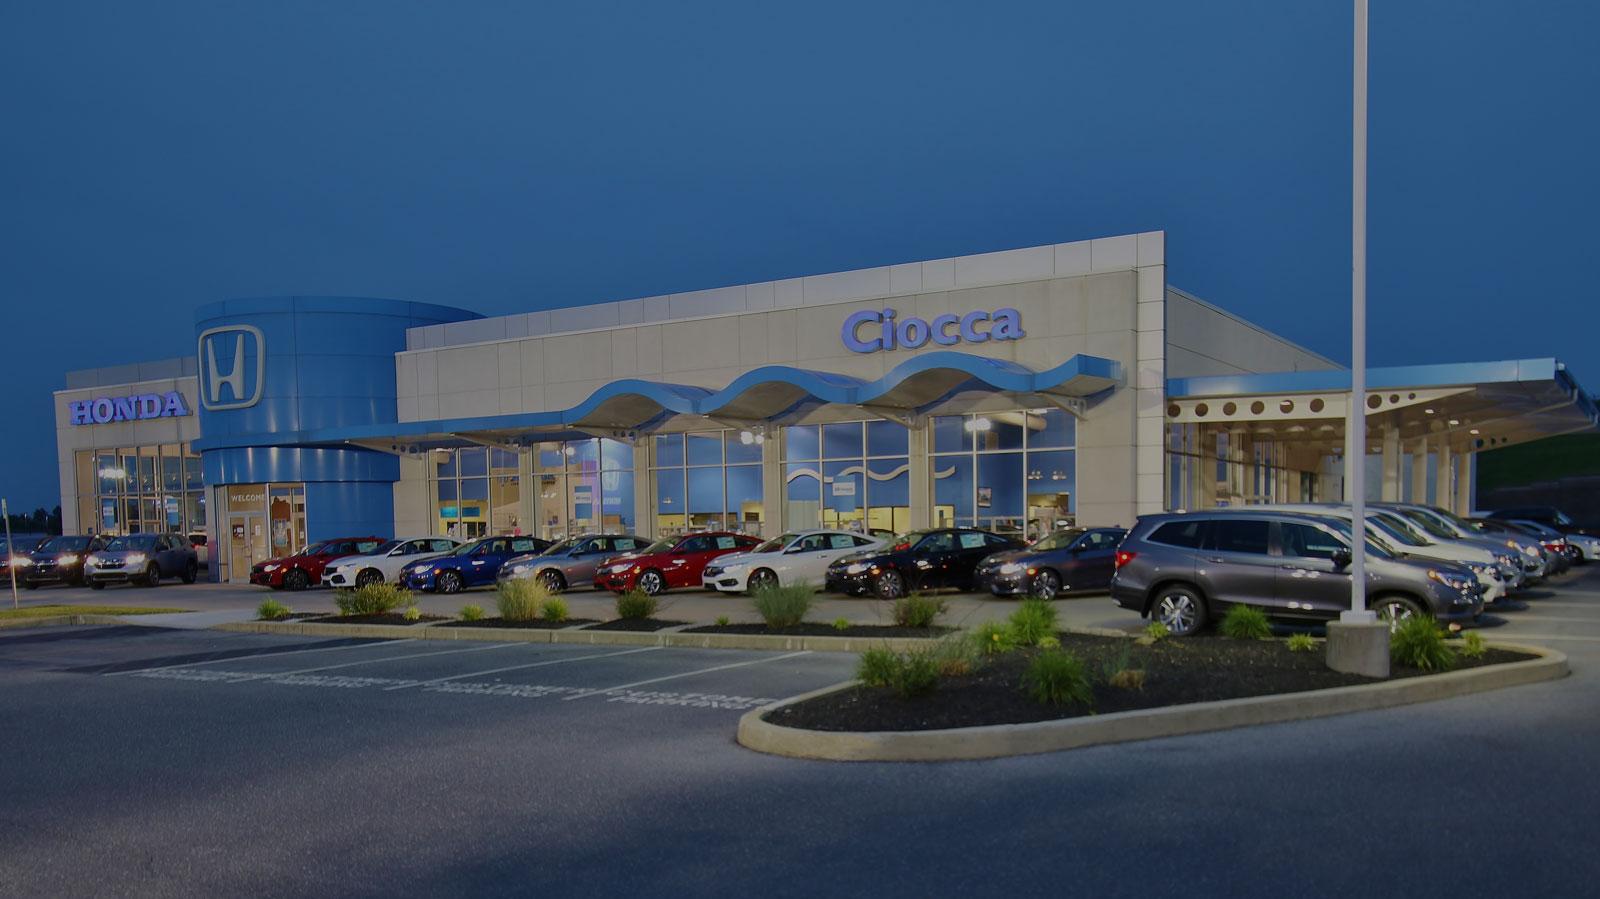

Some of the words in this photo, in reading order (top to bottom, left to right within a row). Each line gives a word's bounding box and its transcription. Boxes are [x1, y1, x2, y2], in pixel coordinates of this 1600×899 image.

[842, 308, 1025, 353] Ciocca
[70, 391, 188, 425] HONDA
[231, 494, 265, 502] WELCOME
